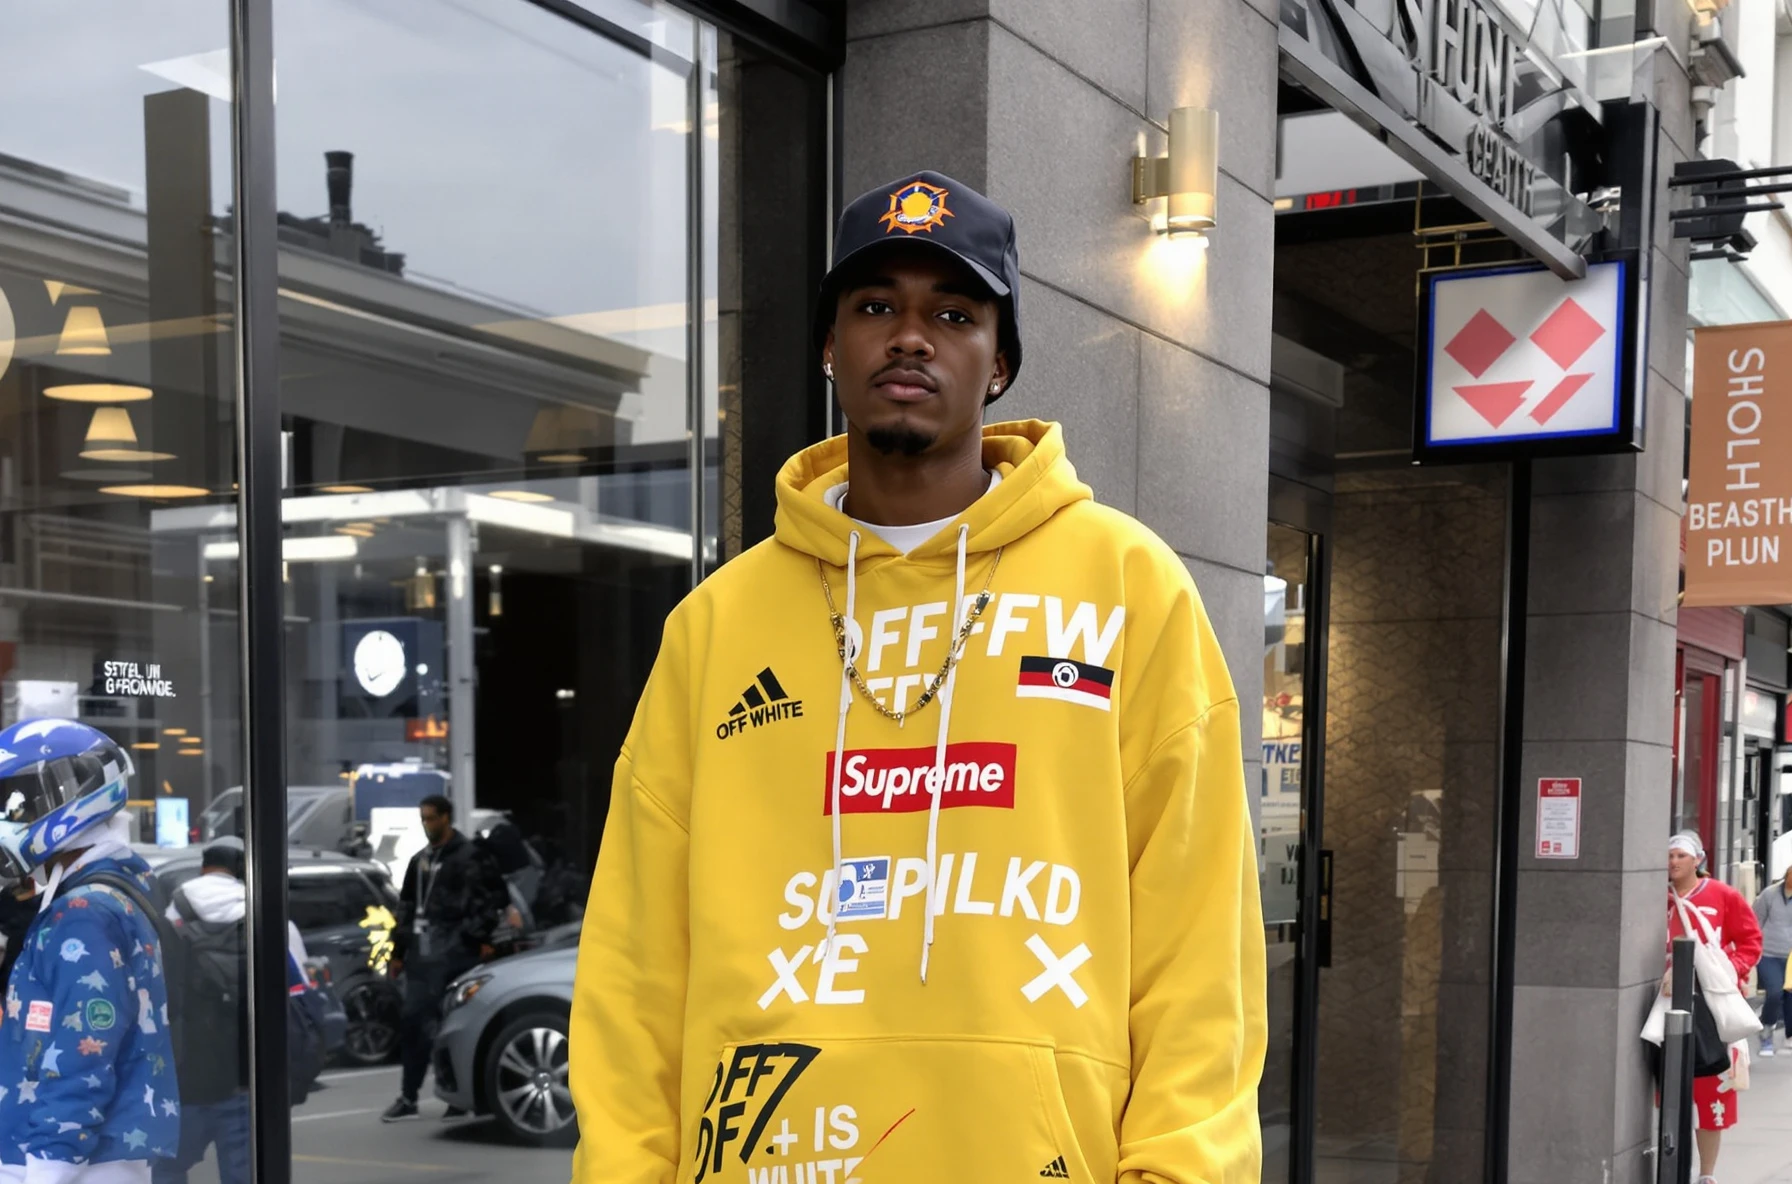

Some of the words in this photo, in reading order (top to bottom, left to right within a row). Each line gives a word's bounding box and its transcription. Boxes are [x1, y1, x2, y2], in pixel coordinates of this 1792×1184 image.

[1707, 535, 1779, 567] PLUN
[716, 714, 747, 740] OFF
[750, 700, 804, 728] WHITE
[841, 754, 1005, 809] Supreme
[814, 1104, 860, 1152] IS
